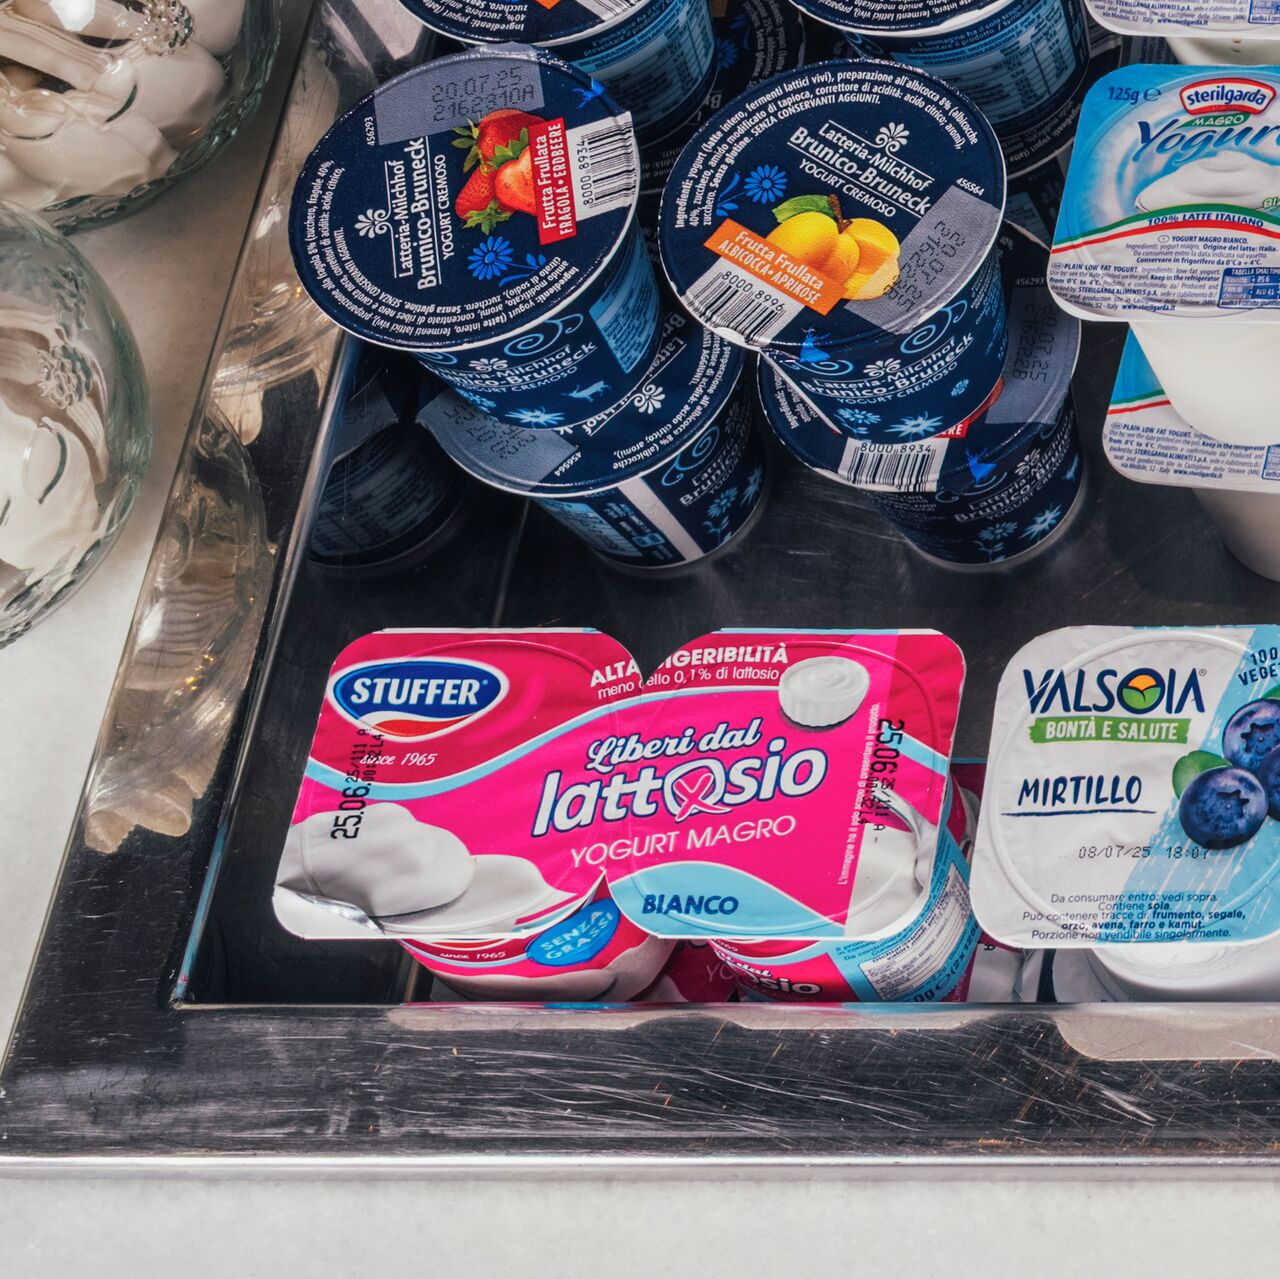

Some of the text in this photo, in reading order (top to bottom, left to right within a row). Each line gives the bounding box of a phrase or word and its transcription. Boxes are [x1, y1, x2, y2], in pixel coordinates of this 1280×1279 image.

[1107, 87, 1140, 103] 125g
[1186, 86, 1267, 106] sterilgarda
[535, 134, 557, 230] Frutta Frullata
[550, 123, 573, 236] FRAGOLA ERDBEERE
[790, 126, 931, 216] Brunico-Bruneck
[818, 122, 933, 192] Latteria-Milchhof
[405, 137, 437, 290] Brunico-Bruneck
[799, 157, 897, 218] YOGURT CREMOSO
[388, 159, 414, 278] Latteria-Milchhof
[735, 230, 825, 290] Frutta Frullata
[349, 673, 482, 709] STUFFER
[590, 643, 788, 688] ALTA IGERIBILITÀ
[1022, 668, 1206, 715] VALSOIA
[585, 717, 763, 772] Liberi dal
[1045, 716, 1179, 741] BONTÀ E SALUTE
[1018, 775, 1142, 806] MIRTILLO
[569, 815, 797, 865] YOGURT MAGRO
[640, 892, 740, 916] BIANCO
